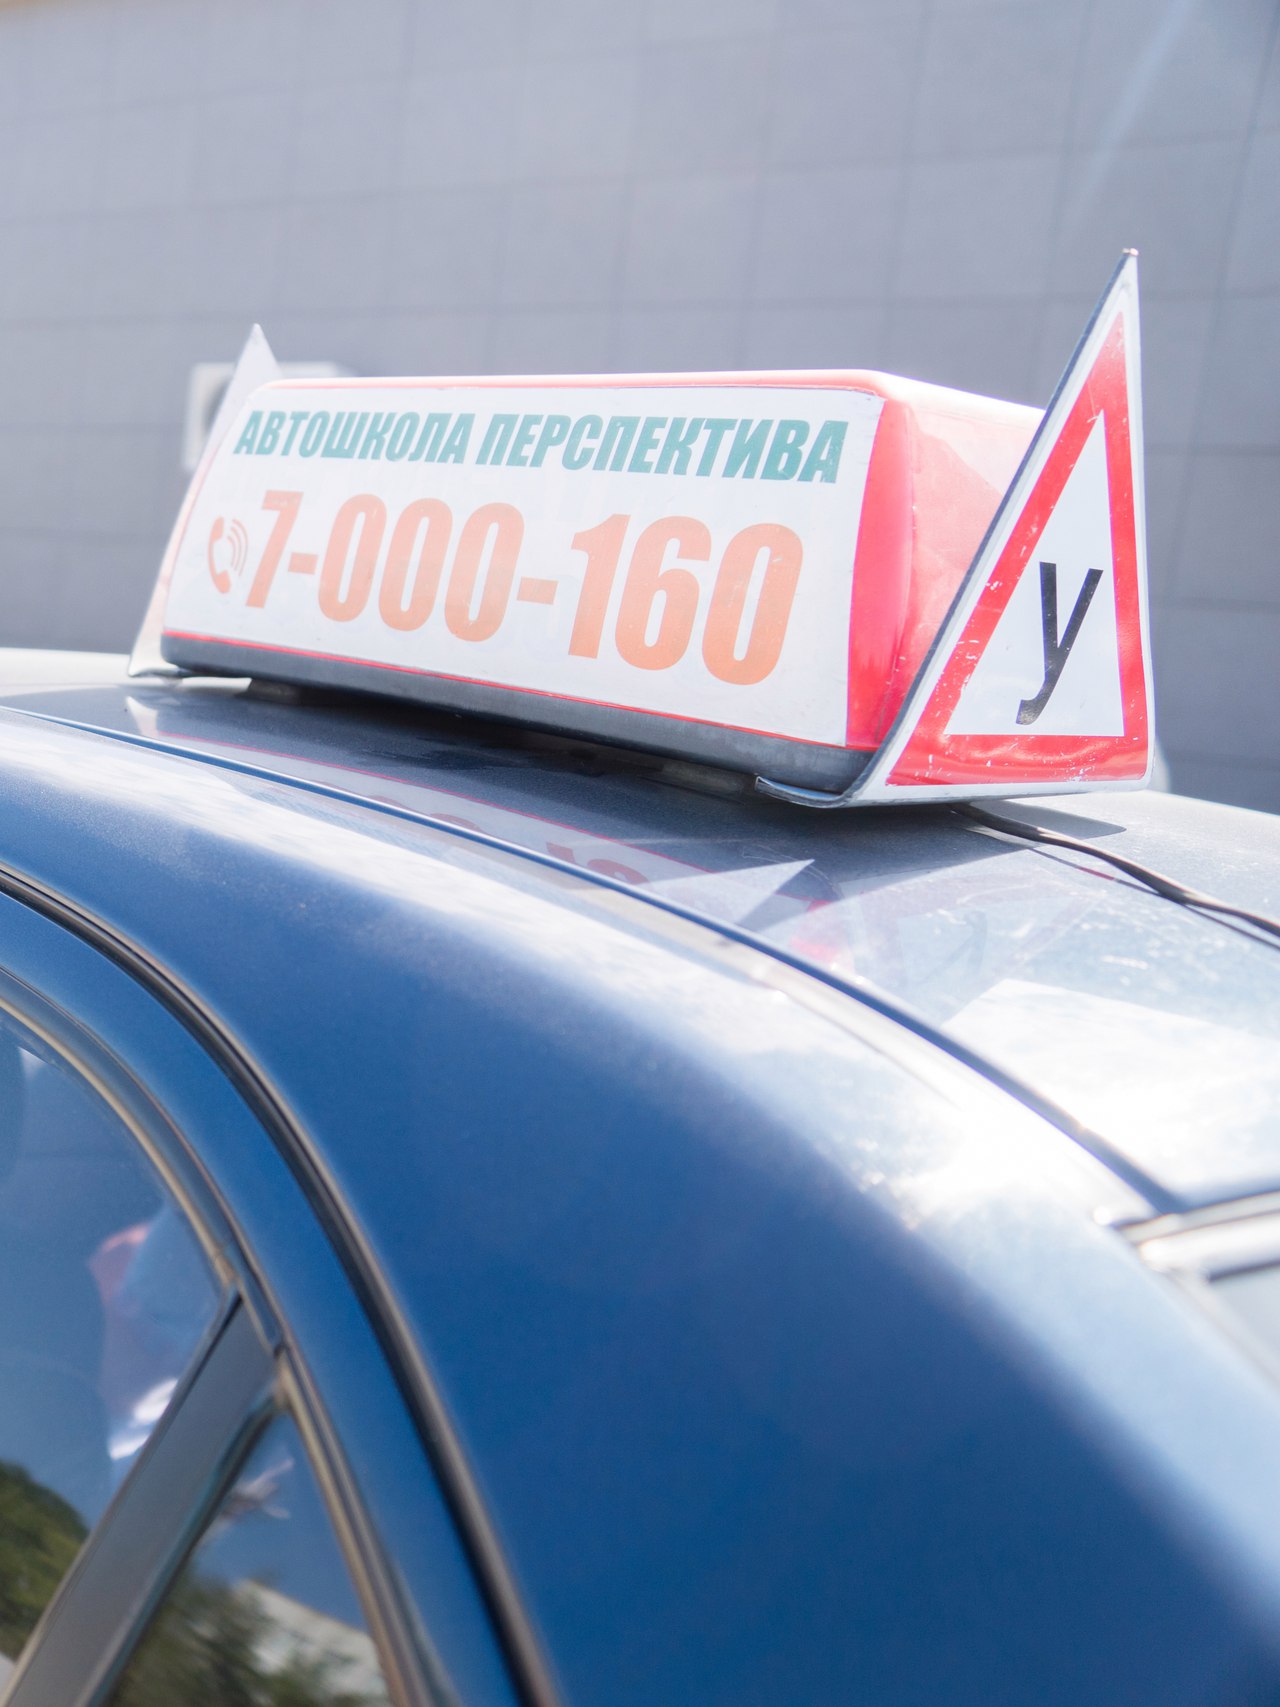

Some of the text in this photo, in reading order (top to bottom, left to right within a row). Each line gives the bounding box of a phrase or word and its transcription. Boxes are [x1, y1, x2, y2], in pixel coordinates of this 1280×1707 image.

[234, 410, 849, 484] АВТОШКОЛА ПЕРСПЕКТИВА
[245, 490, 804, 686] 7-000-160
